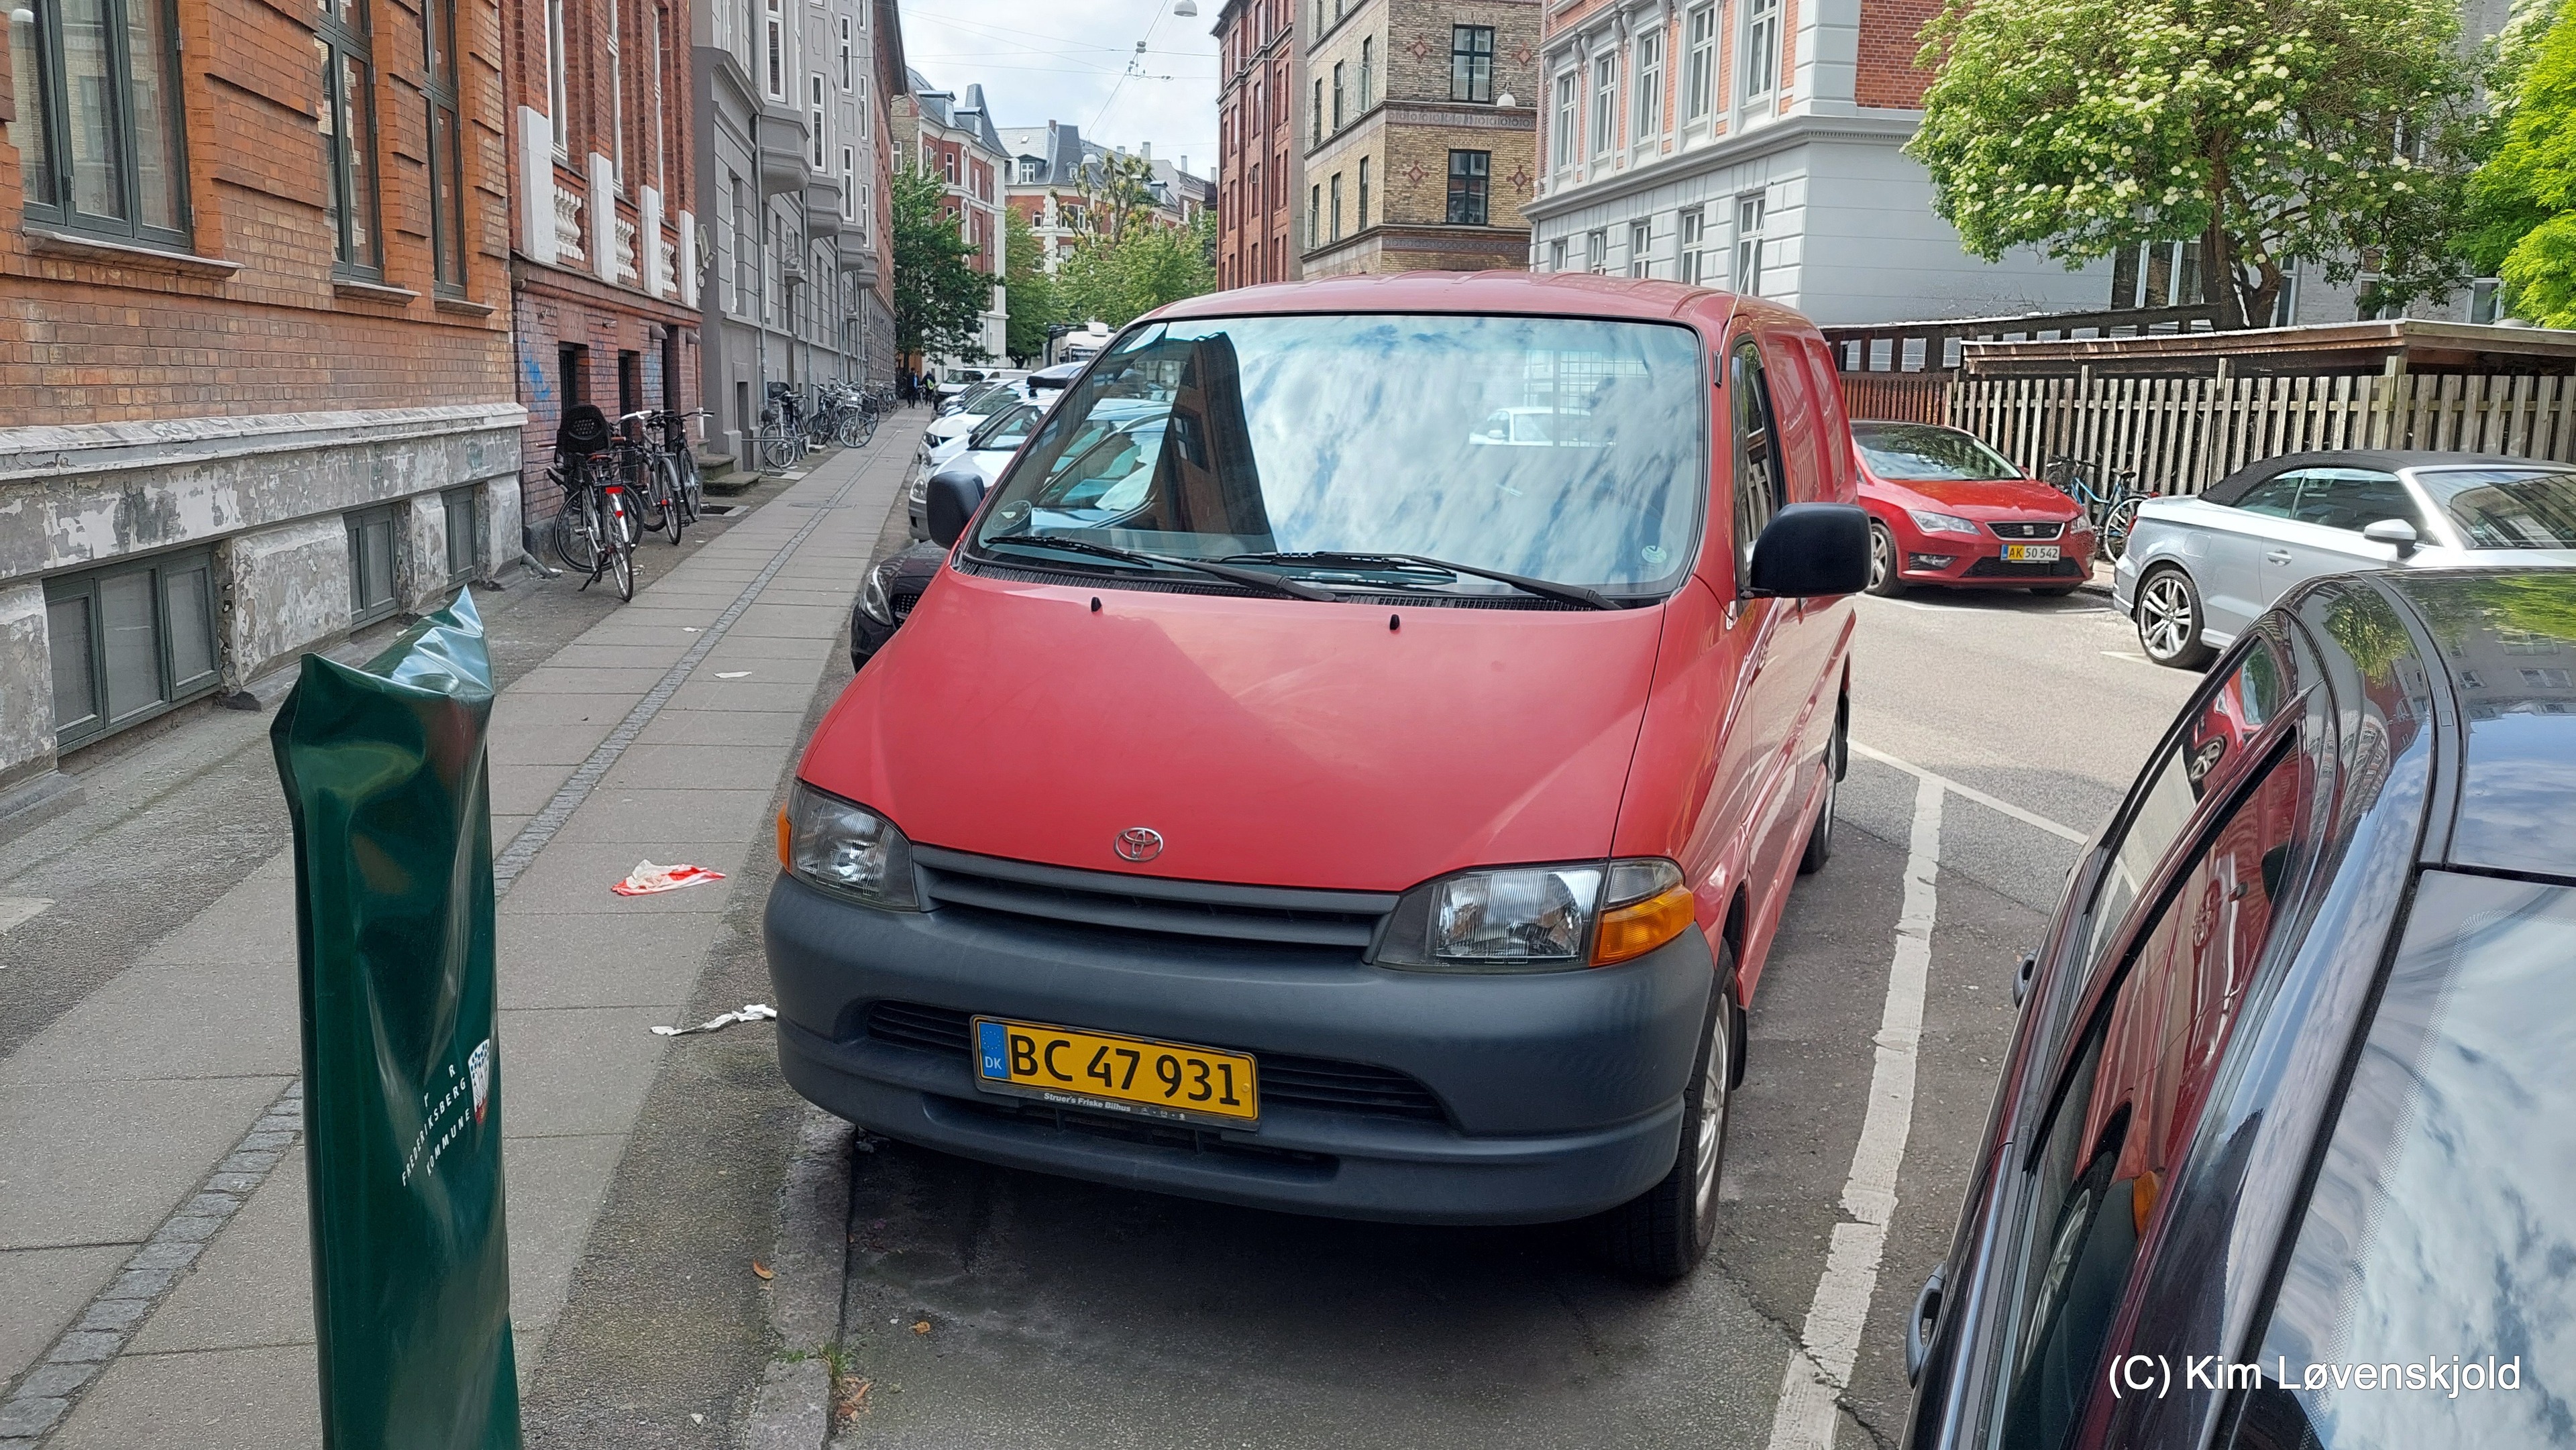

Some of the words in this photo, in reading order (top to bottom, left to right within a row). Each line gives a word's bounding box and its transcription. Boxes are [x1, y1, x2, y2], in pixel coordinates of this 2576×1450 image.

[2008, 547, 2023, 558] AK
[2025, 547, 2037, 558] 50
[2039, 547, 2058, 558] 542
[984, 1056, 1002, 1070] DK
[1010, 1034, 1073, 1082] BC
[1087, 1045, 1141, 1091] 47
[1156, 1054, 1241, 1107] 931
[1044, 1092, 1076, 1105] Struer's
[1077, 1097, 1104, 1109] Friske
[1105, 1101, 1131, 1113] Bilhus
[402, 1077, 466, 1187] FREDERIKSBERG
[426, 1108, 470, 1177] KOMMUNE
